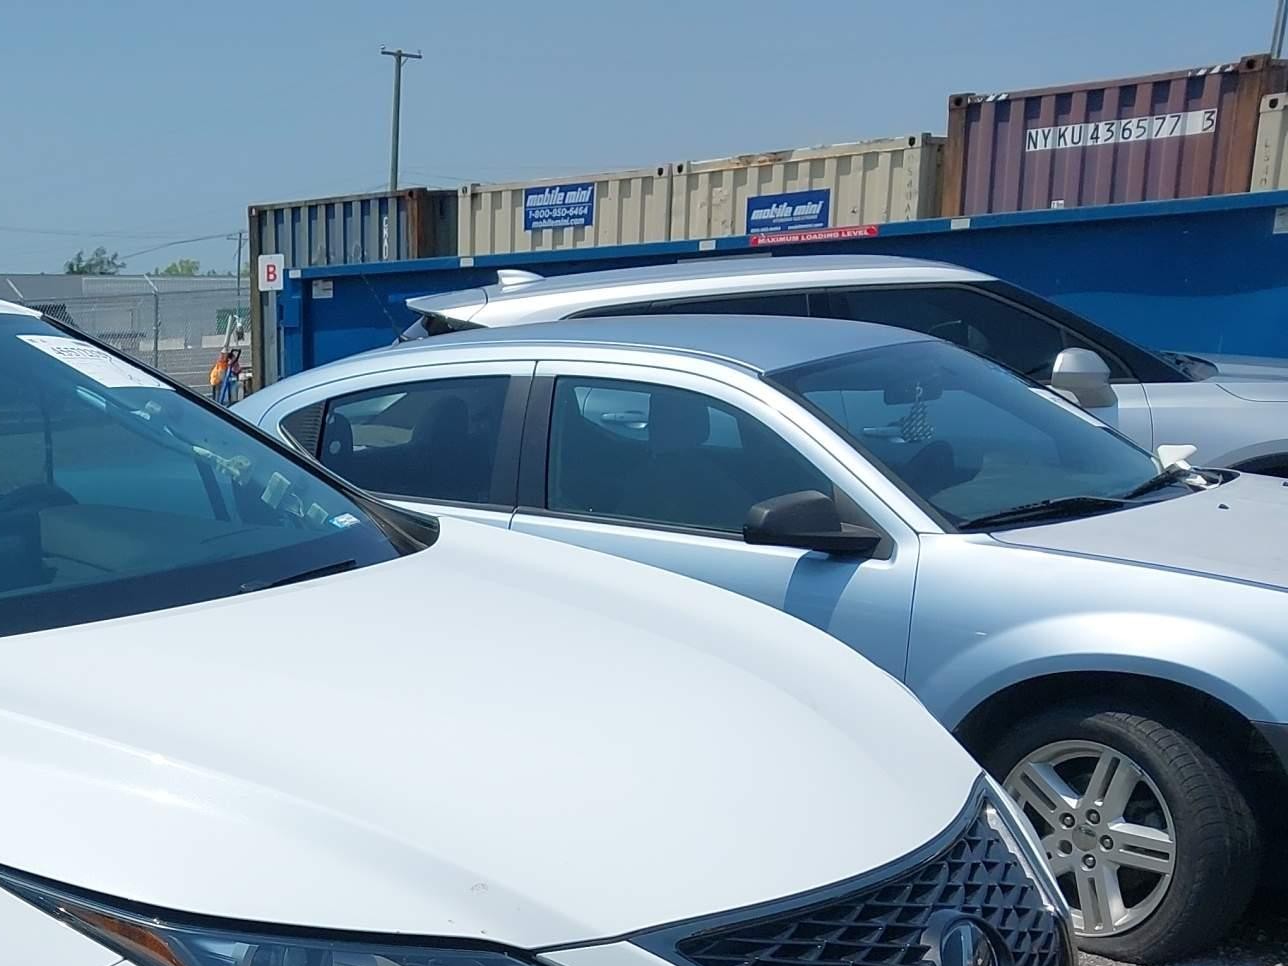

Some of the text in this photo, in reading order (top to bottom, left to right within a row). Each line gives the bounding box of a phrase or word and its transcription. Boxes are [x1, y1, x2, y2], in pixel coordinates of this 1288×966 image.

[1026, 110, 1217, 150] NYKU 436577 3
[526, 185, 593, 207] mobile mini
[750, 202, 794, 221] mobile
[792, 200, 825, 217] mini
[757, 229, 868, 244] MAXIMUM LOADING LEVEL
[266, 264, 278, 282] B
